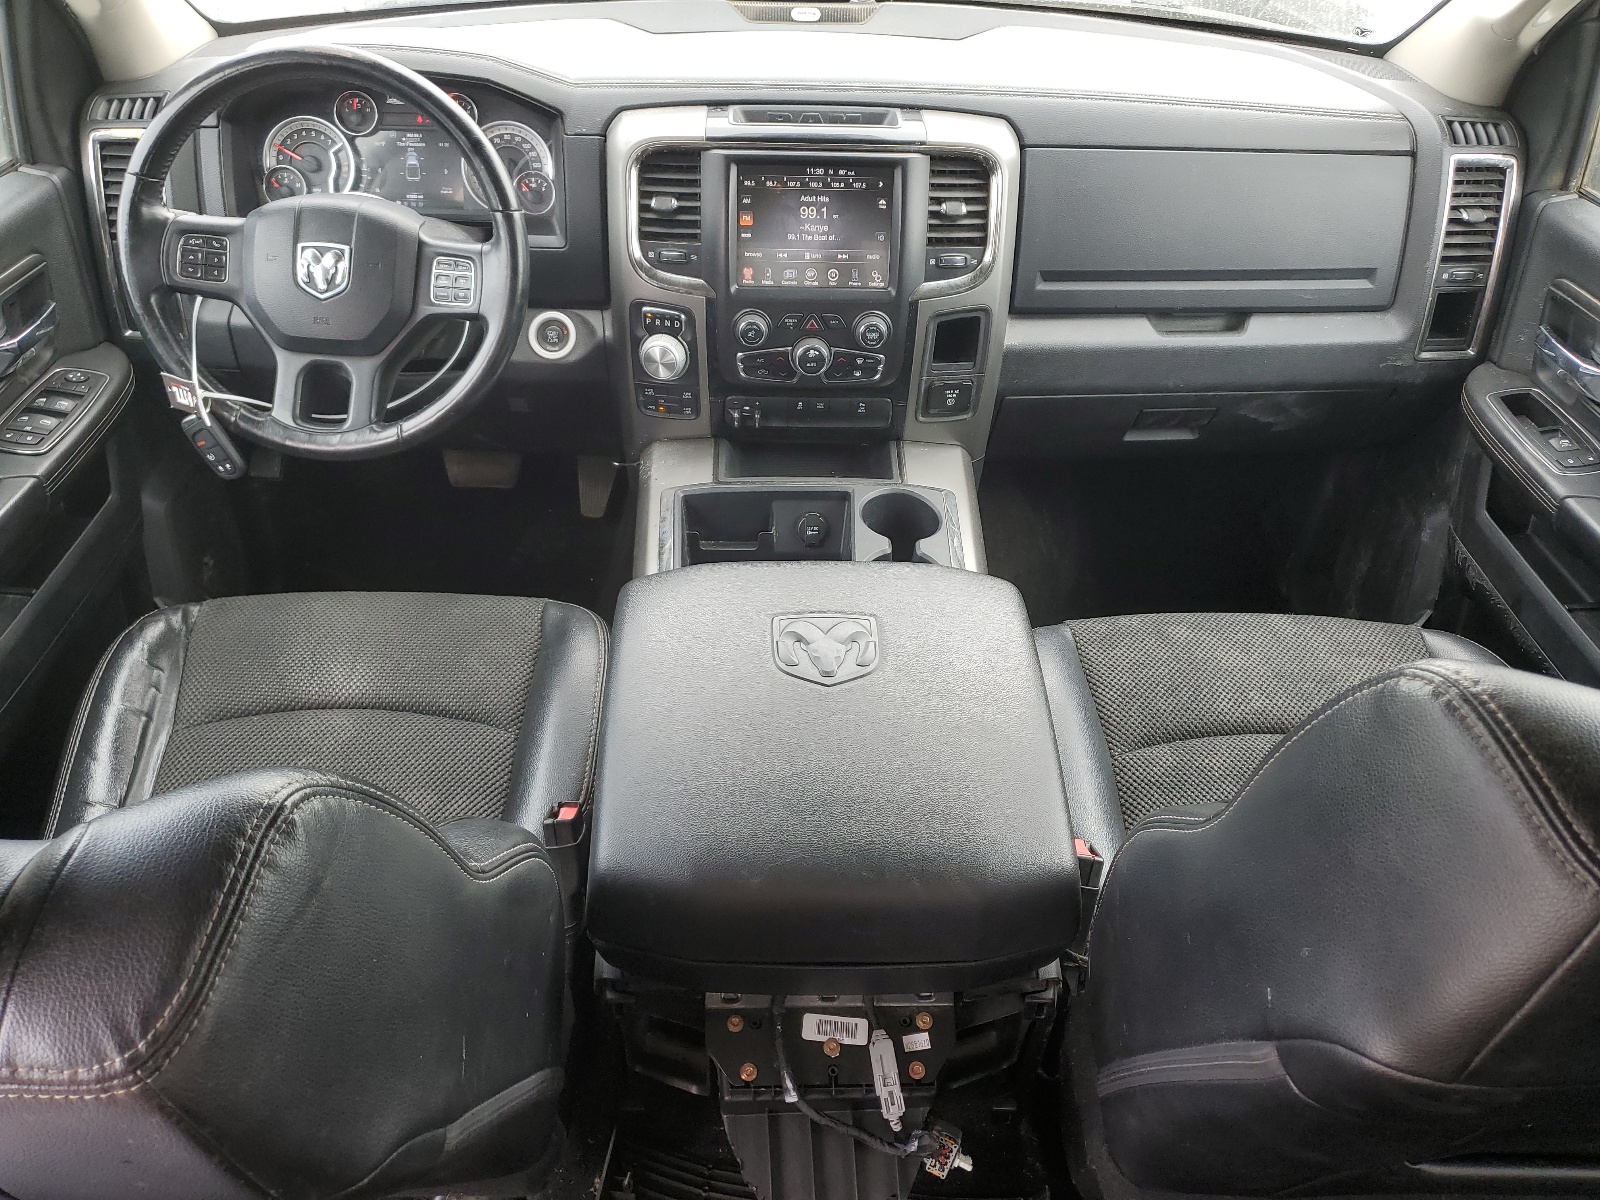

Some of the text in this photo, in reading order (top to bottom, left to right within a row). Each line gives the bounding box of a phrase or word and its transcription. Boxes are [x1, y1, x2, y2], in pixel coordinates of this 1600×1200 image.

[806, 167, 825, 176] 11:30
[800, 194, 816, 202] Adult
[800, 206, 828, 219] 99.1
[664, 319, 671, 327] N
